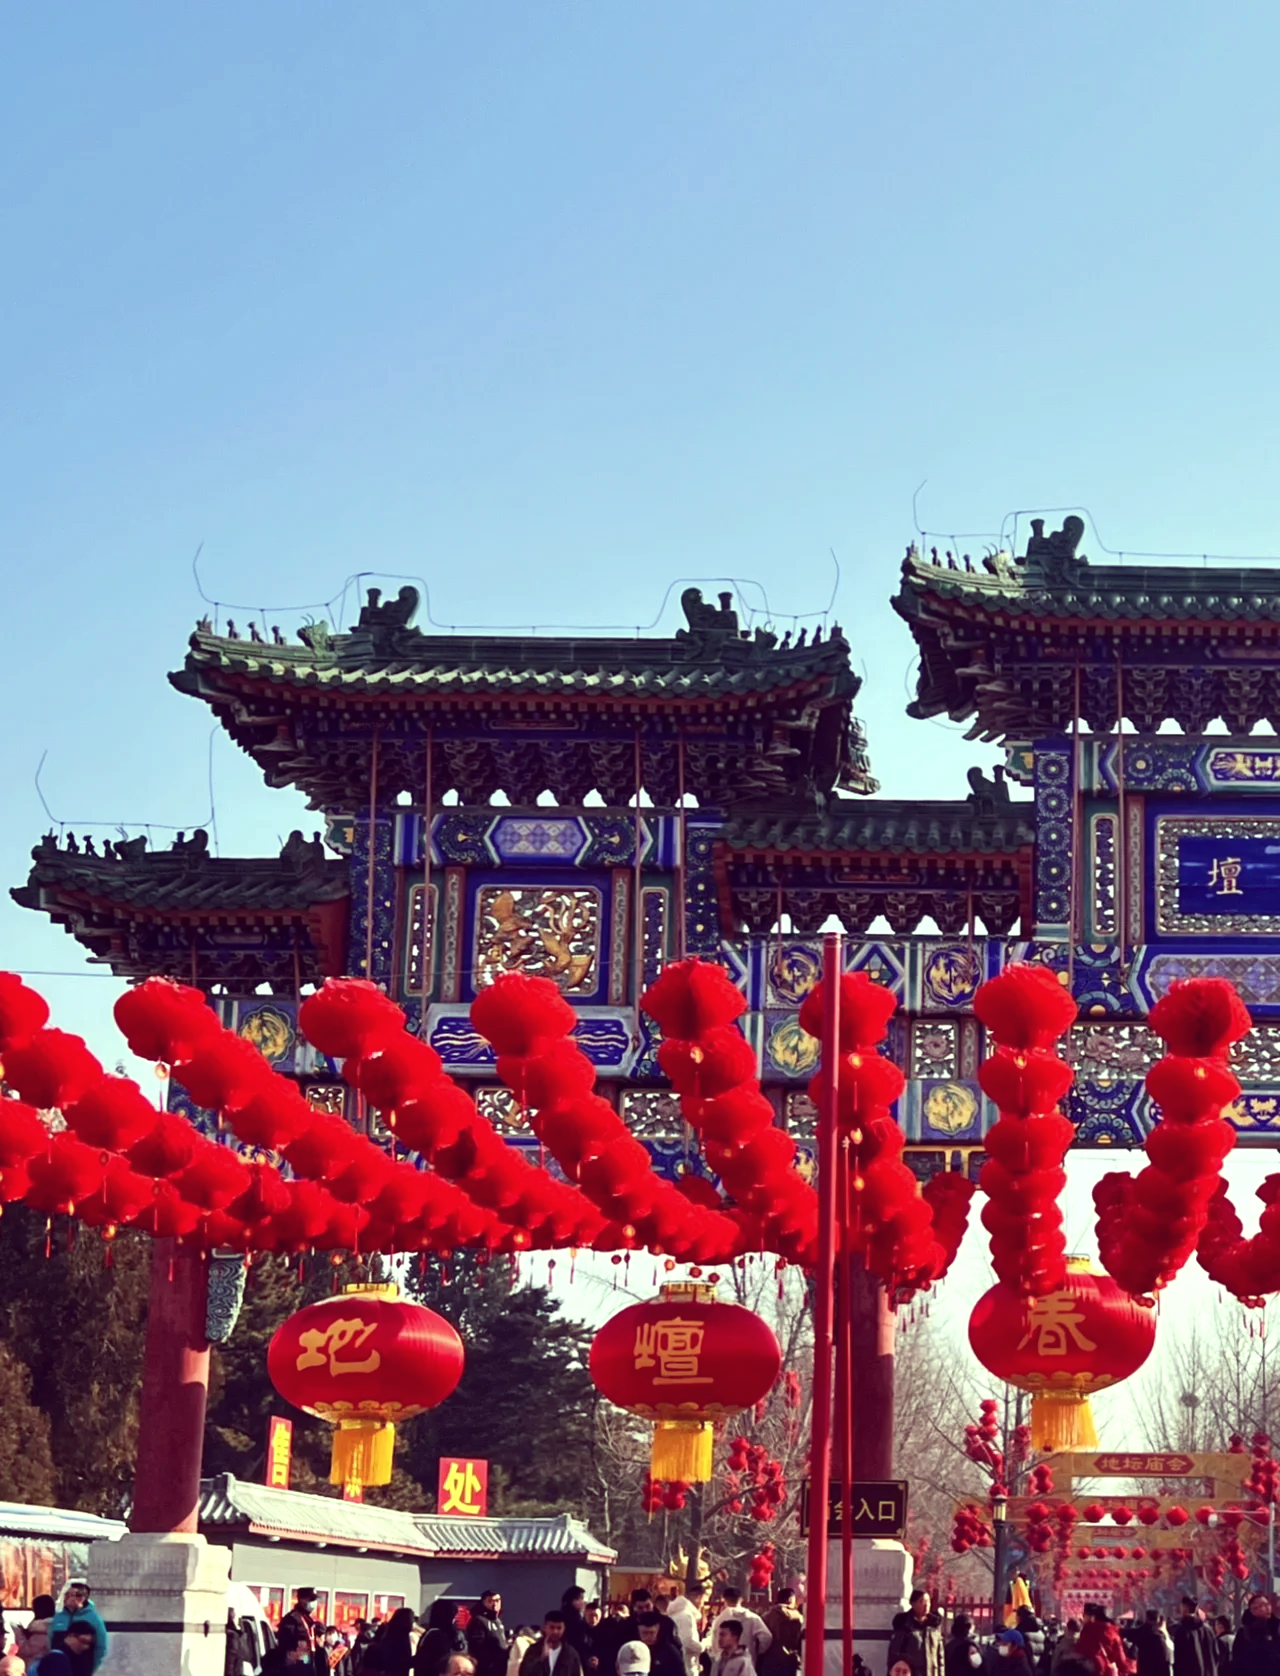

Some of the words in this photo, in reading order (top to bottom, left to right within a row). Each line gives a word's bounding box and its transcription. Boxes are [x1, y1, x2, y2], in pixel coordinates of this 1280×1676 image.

[295, 1317, 380, 1377] 地
[1016, 1290, 1097, 1356] 春
[441, 1462, 481, 1514] 处
[1101, 1456, 1187, 1472] 地坛庙会
